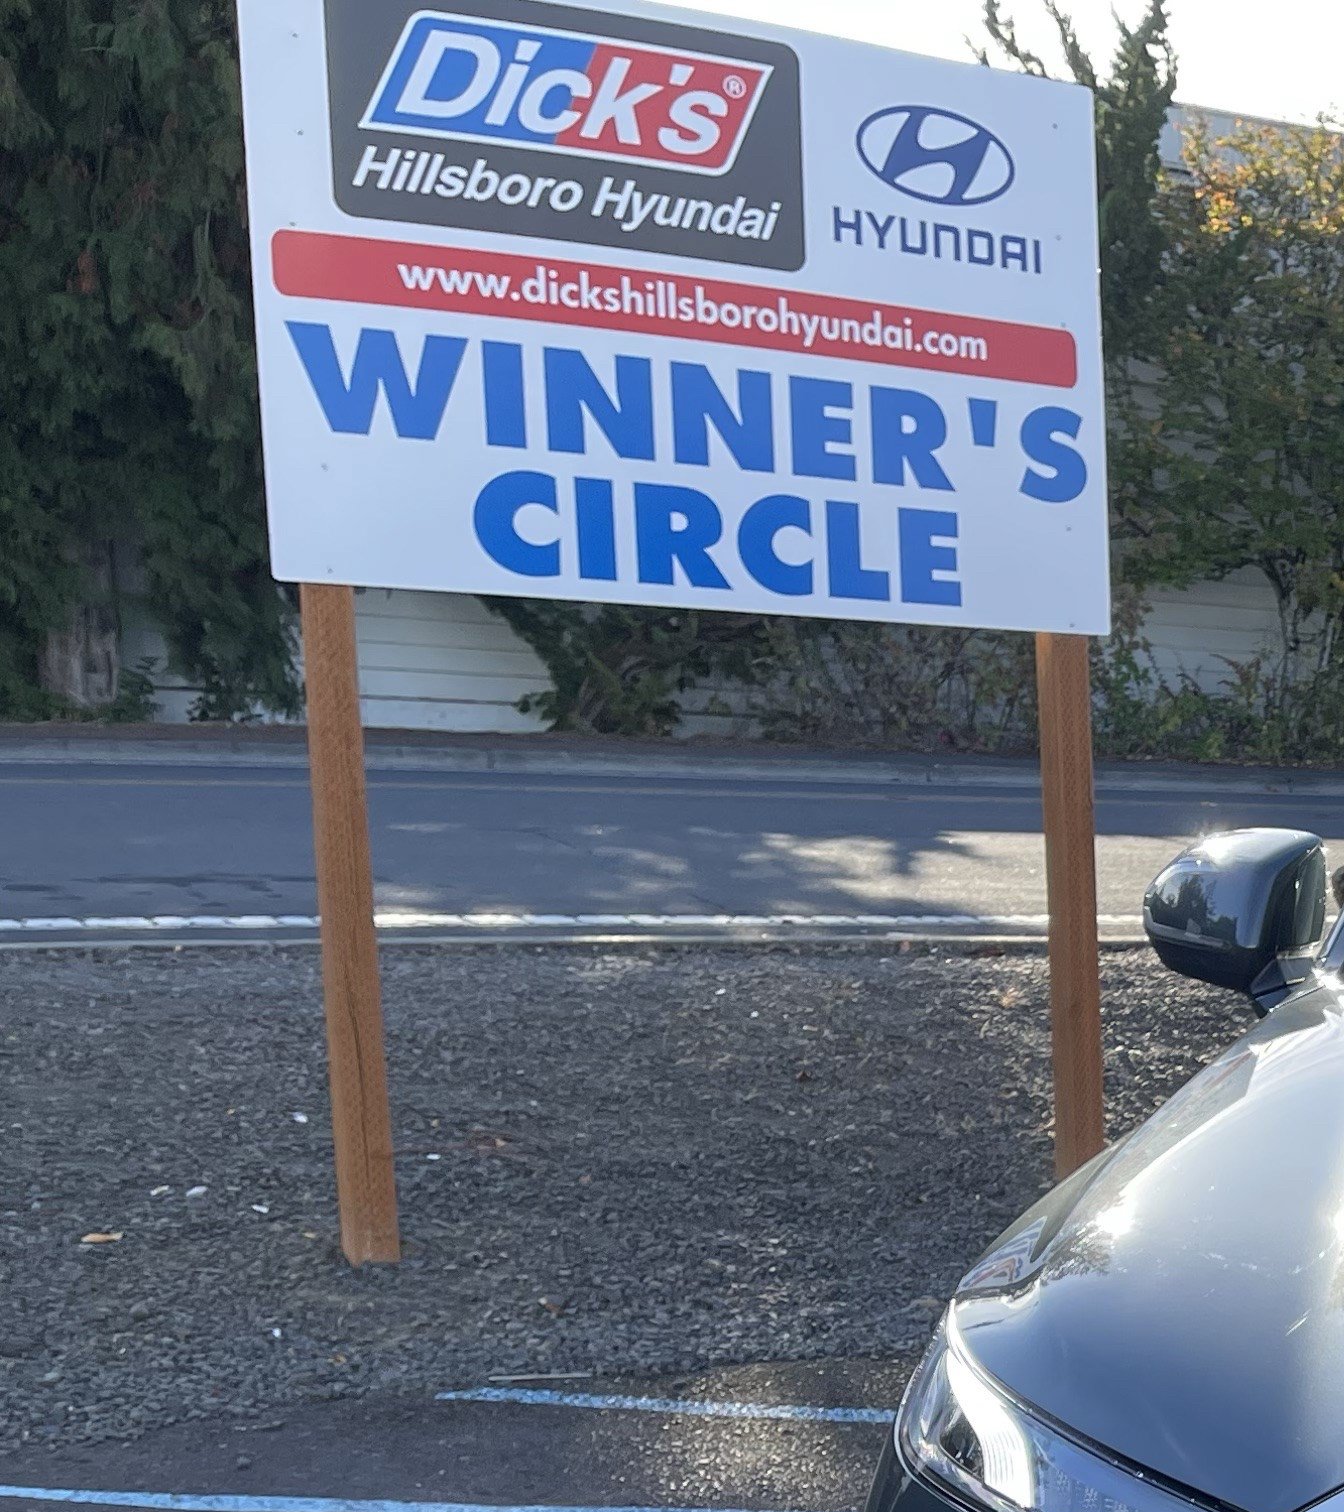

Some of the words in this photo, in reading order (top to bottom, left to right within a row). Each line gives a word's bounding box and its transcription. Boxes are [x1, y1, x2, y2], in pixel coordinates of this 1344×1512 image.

[352, 146, 583, 212] Hillsboro
[591, 177, 782, 241] Hyundai
[833, 206, 1042, 274] HYUNDAI
[398, 263, 988, 361] www.dickshillsborohyundai.com
[284, 320, 1088, 503] WINNER'S
[473, 470, 963, 607] CIRCLE
